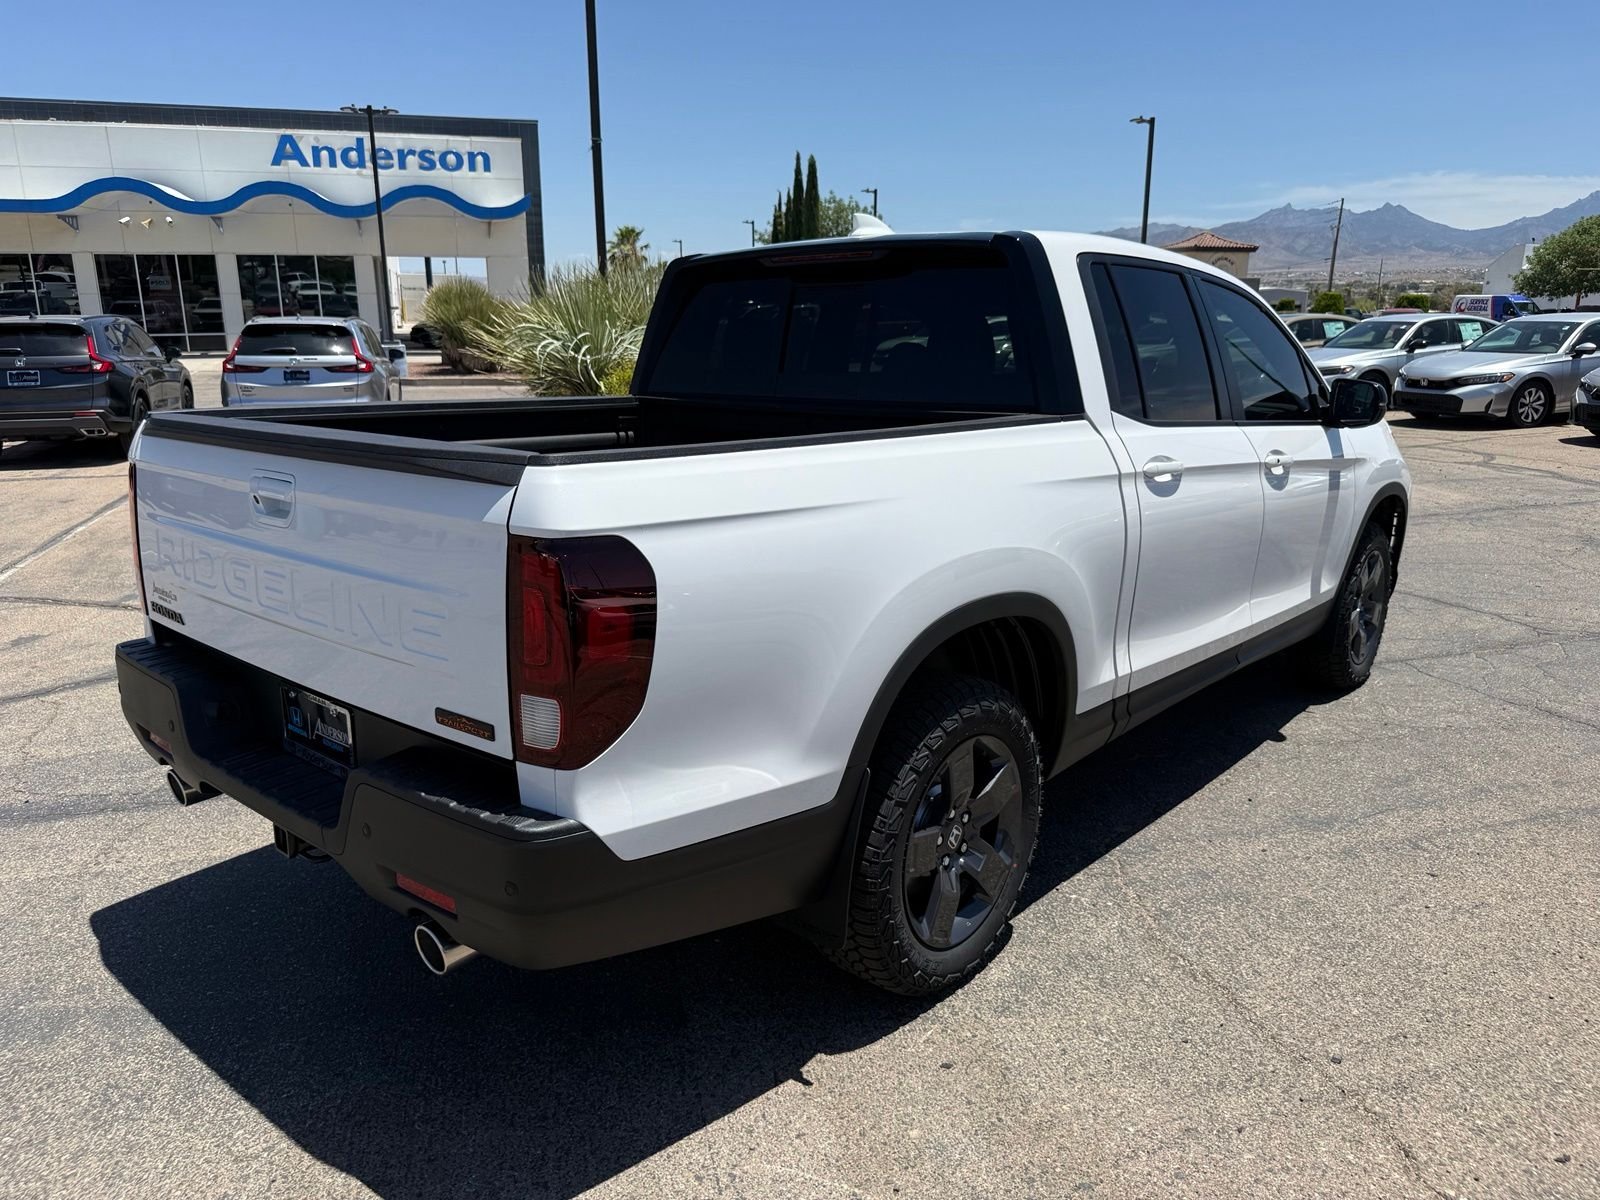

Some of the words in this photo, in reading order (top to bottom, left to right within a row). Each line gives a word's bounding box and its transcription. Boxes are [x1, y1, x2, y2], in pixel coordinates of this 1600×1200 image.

[271, 134, 491, 172] Anderson
[150, 600, 186, 626] HONDA
[154, 528, 449, 662] RIDGELINE
